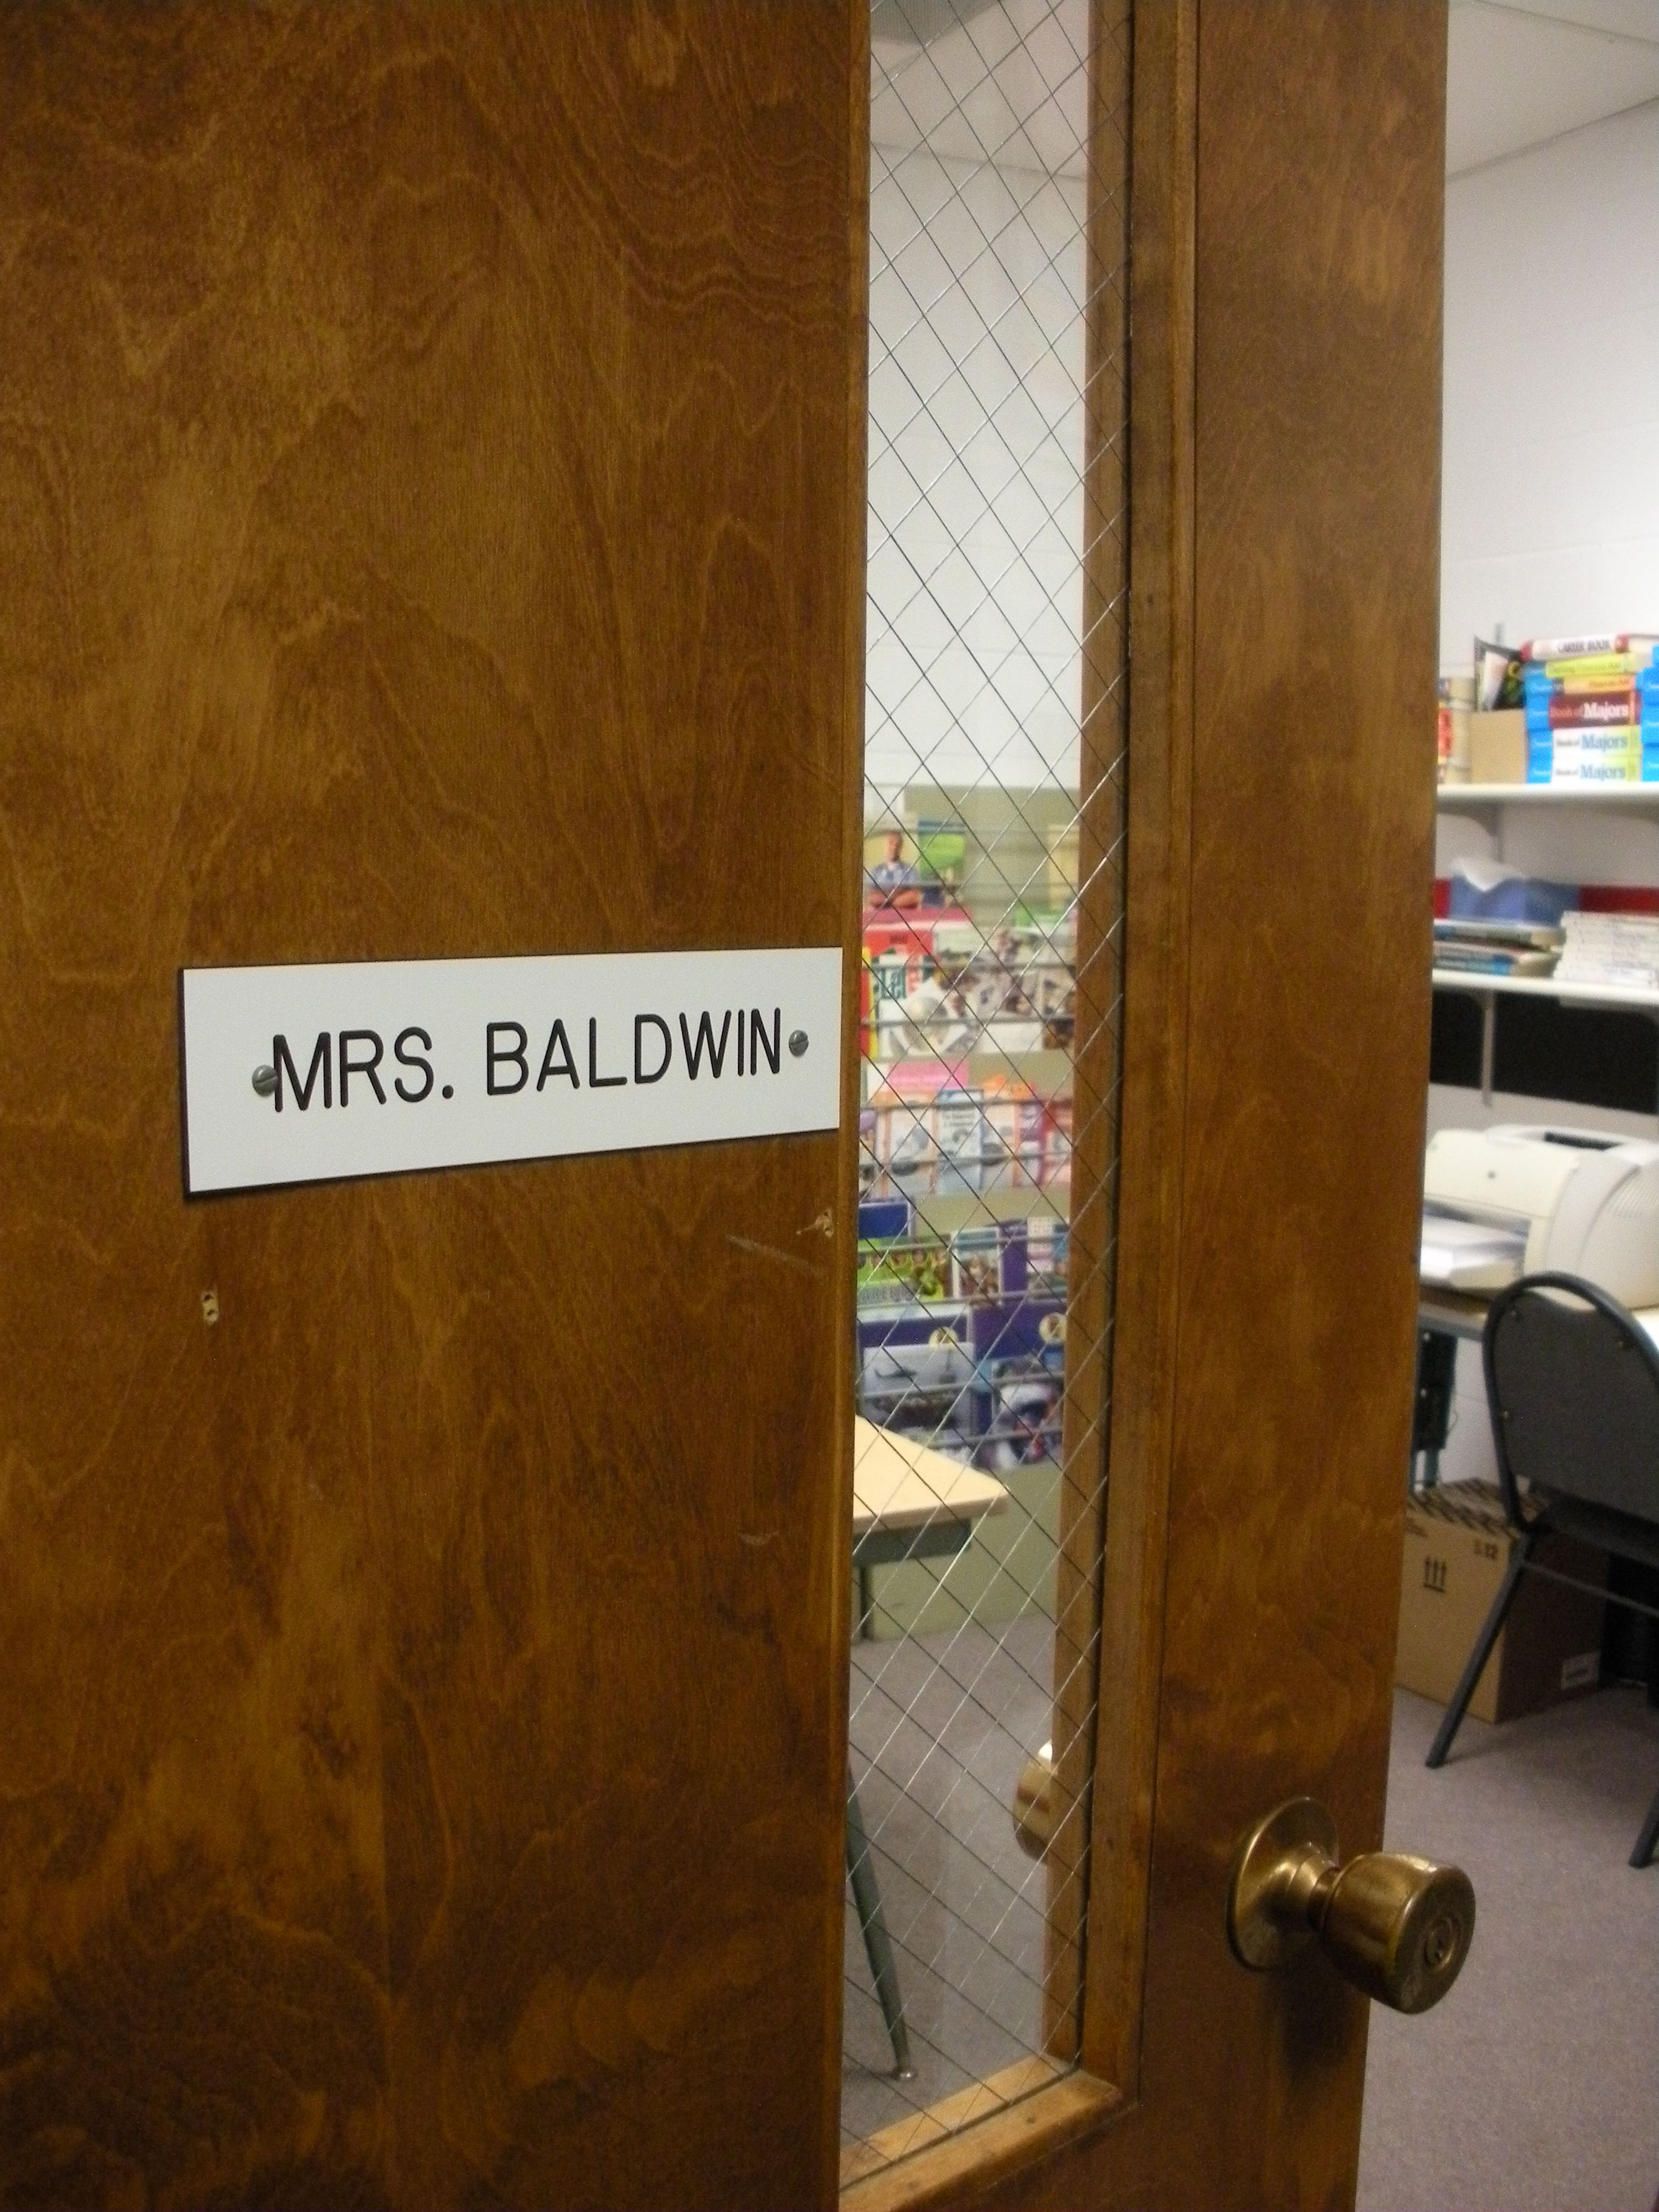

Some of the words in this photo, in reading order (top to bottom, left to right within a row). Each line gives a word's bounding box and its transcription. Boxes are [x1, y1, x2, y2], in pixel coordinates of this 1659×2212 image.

[1583, 702, 1629, 722] Majors
[1582, 734, 1628, 752] Majors
[1581, 764, 1626, 781] Majors
[273, 1026, 454, 1112] MRS.
[486, 1008, 781, 1095] BALDWIN
